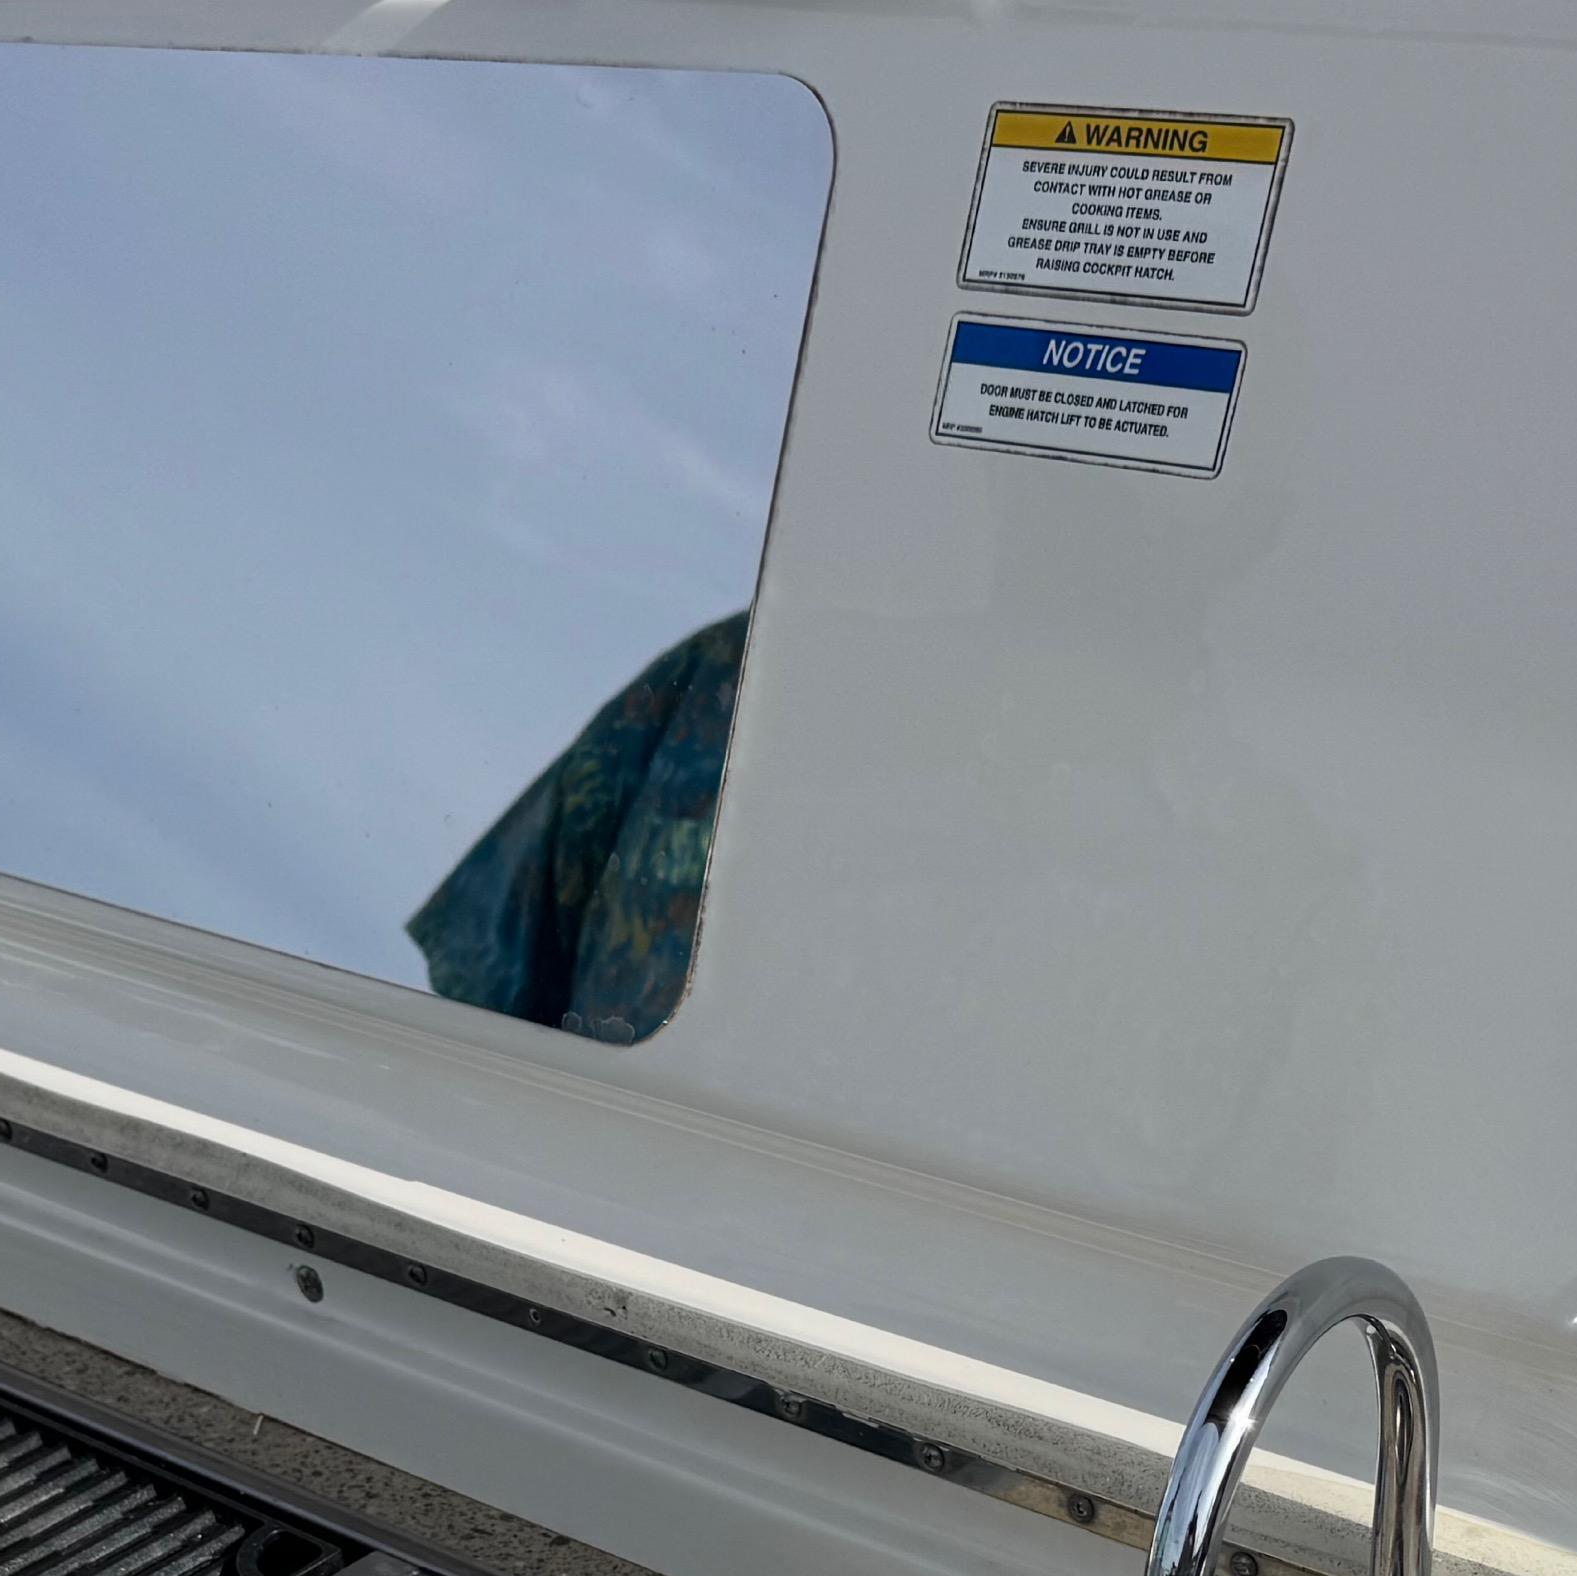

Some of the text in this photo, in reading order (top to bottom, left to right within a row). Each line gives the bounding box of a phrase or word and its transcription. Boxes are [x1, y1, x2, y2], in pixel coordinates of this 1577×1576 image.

[1085, 123, 1208, 153] WARNING
[1021, 160, 1233, 186] SEVERE INJURY COULD RESULT FROM
[1032, 180, 1212, 204] CONTACT WITH HOT GREASE OR
[1070, 202, 1163, 220] COOKING ITEMS.
[1020, 218, 1208, 243] ENSURE GRILL IS NOT IN USE AND
[1006, 236, 1216, 264] GREASE DRIP TRAY IS EMPTY BEFORE
[1034, 257, 1176, 280] RAISING COCKPIT HATCH.
[1042, 338, 1146, 375] NOTICE
[979, 383, 1188, 419] DOOR MUST BE CLOSED AND LATCHED FOR
[988, 404, 1170, 438] ENGINE HATCH LIFT TO BE ACTUATED.
